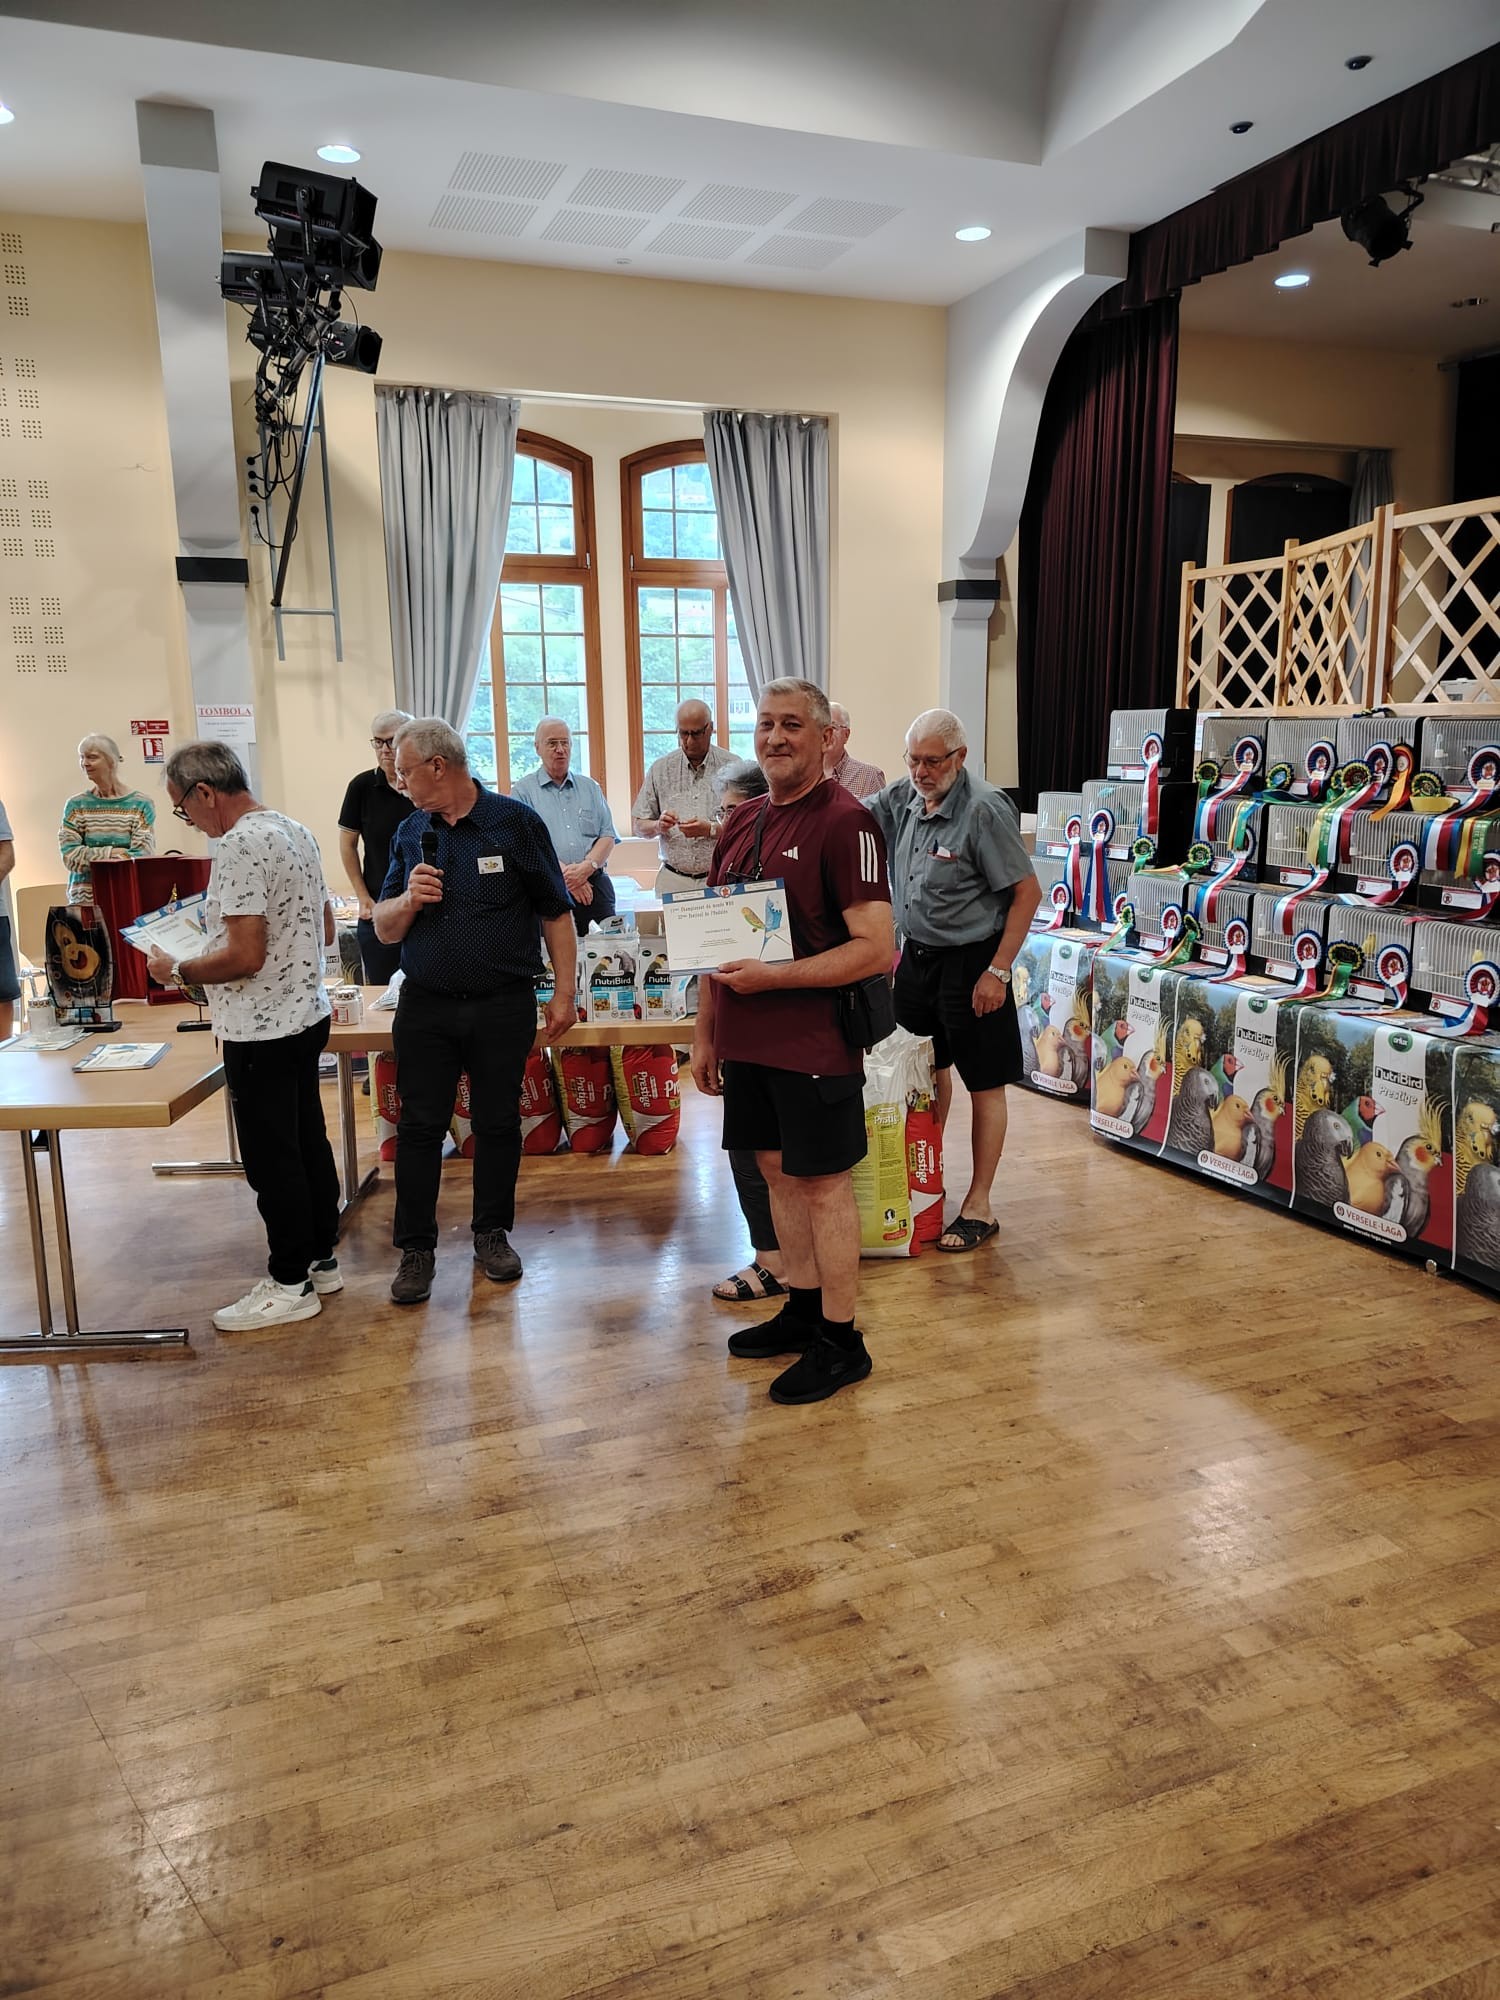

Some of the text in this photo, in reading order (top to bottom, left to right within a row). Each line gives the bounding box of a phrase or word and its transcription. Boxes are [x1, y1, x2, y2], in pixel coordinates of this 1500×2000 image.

[200, 707, 251, 716] TOMBOLA
[594, 976, 632, 985] NutriBird
[1237, 1027, 1274, 1046] NutriBird
[1240, 1044, 1270, 1061] Prestige
[1375, 1066, 1423, 1089] NutriBird
[638, 1071, 650, 1108] Prestige
[1378, 1085, 1418, 1106] Prestige
[916, 1139, 927, 1184] Prestige
[1210, 1156, 1255, 1180] VERSELE-LAGA
[1346, 1210, 1402, 1237] VERSELE-LAGA
